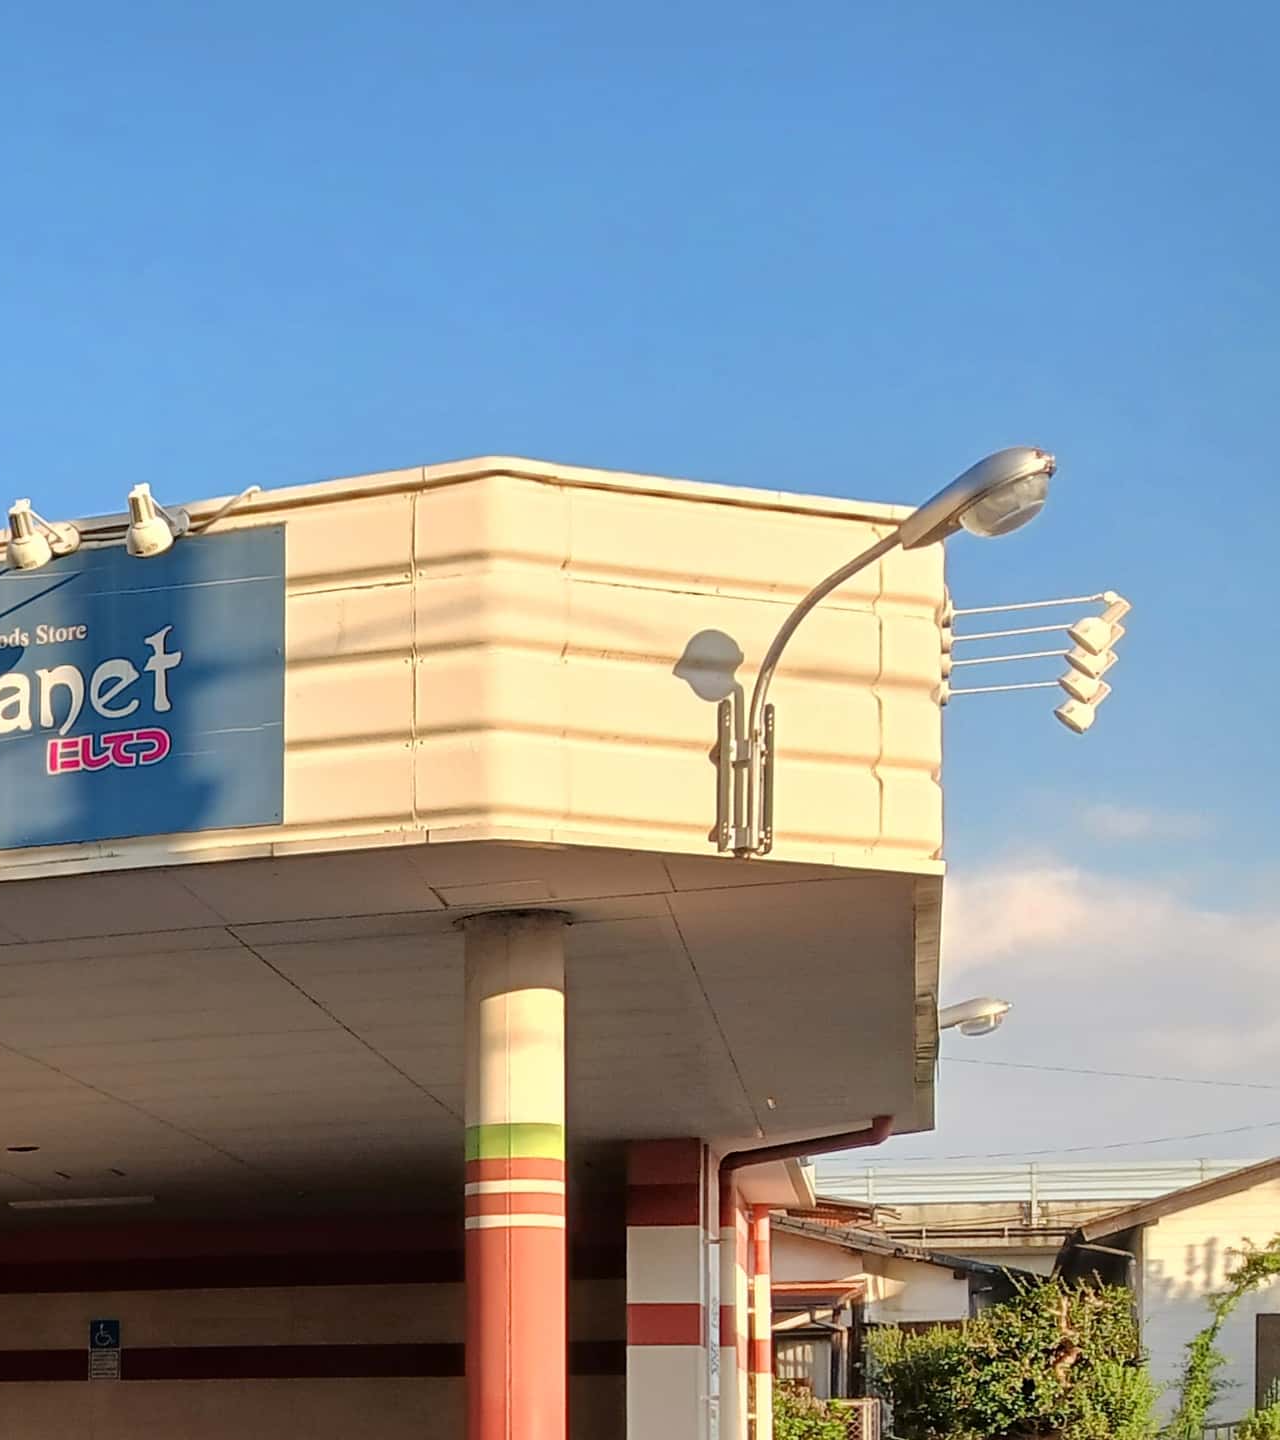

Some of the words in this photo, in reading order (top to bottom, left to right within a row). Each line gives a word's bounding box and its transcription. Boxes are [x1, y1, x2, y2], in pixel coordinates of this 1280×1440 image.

[36, 624, 88, 646] Store
[47, 728, 171, 775] にしてつ
